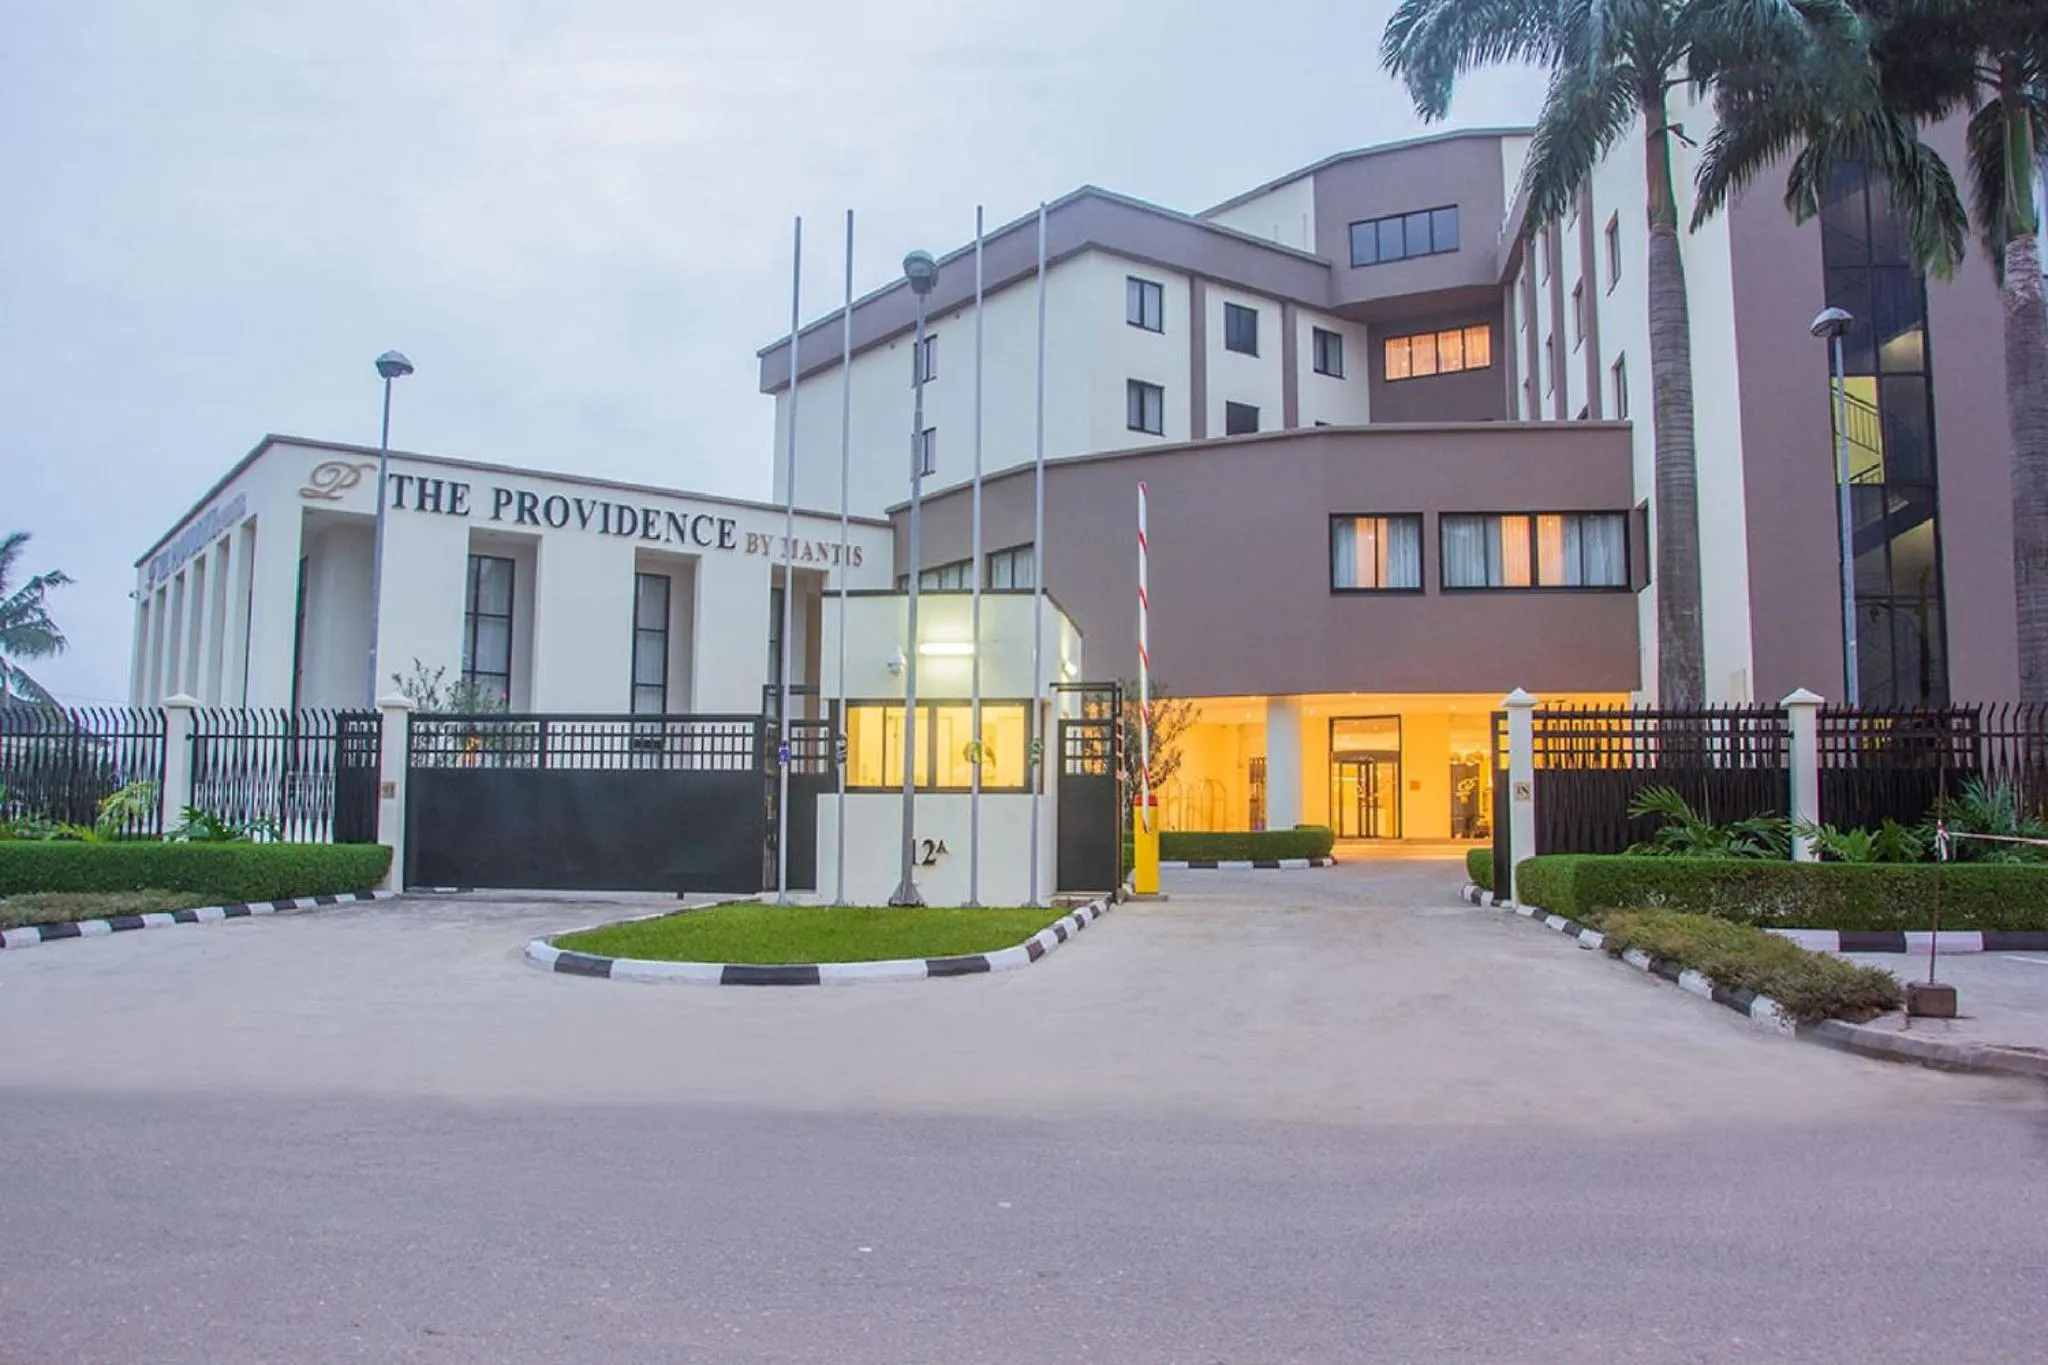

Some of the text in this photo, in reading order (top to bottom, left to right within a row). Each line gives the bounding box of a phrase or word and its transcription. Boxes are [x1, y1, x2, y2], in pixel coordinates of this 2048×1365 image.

[388, 473, 471, 517] THE
[489, 487, 737, 550] PROVIDENCE
[745, 532, 773, 556] BY
